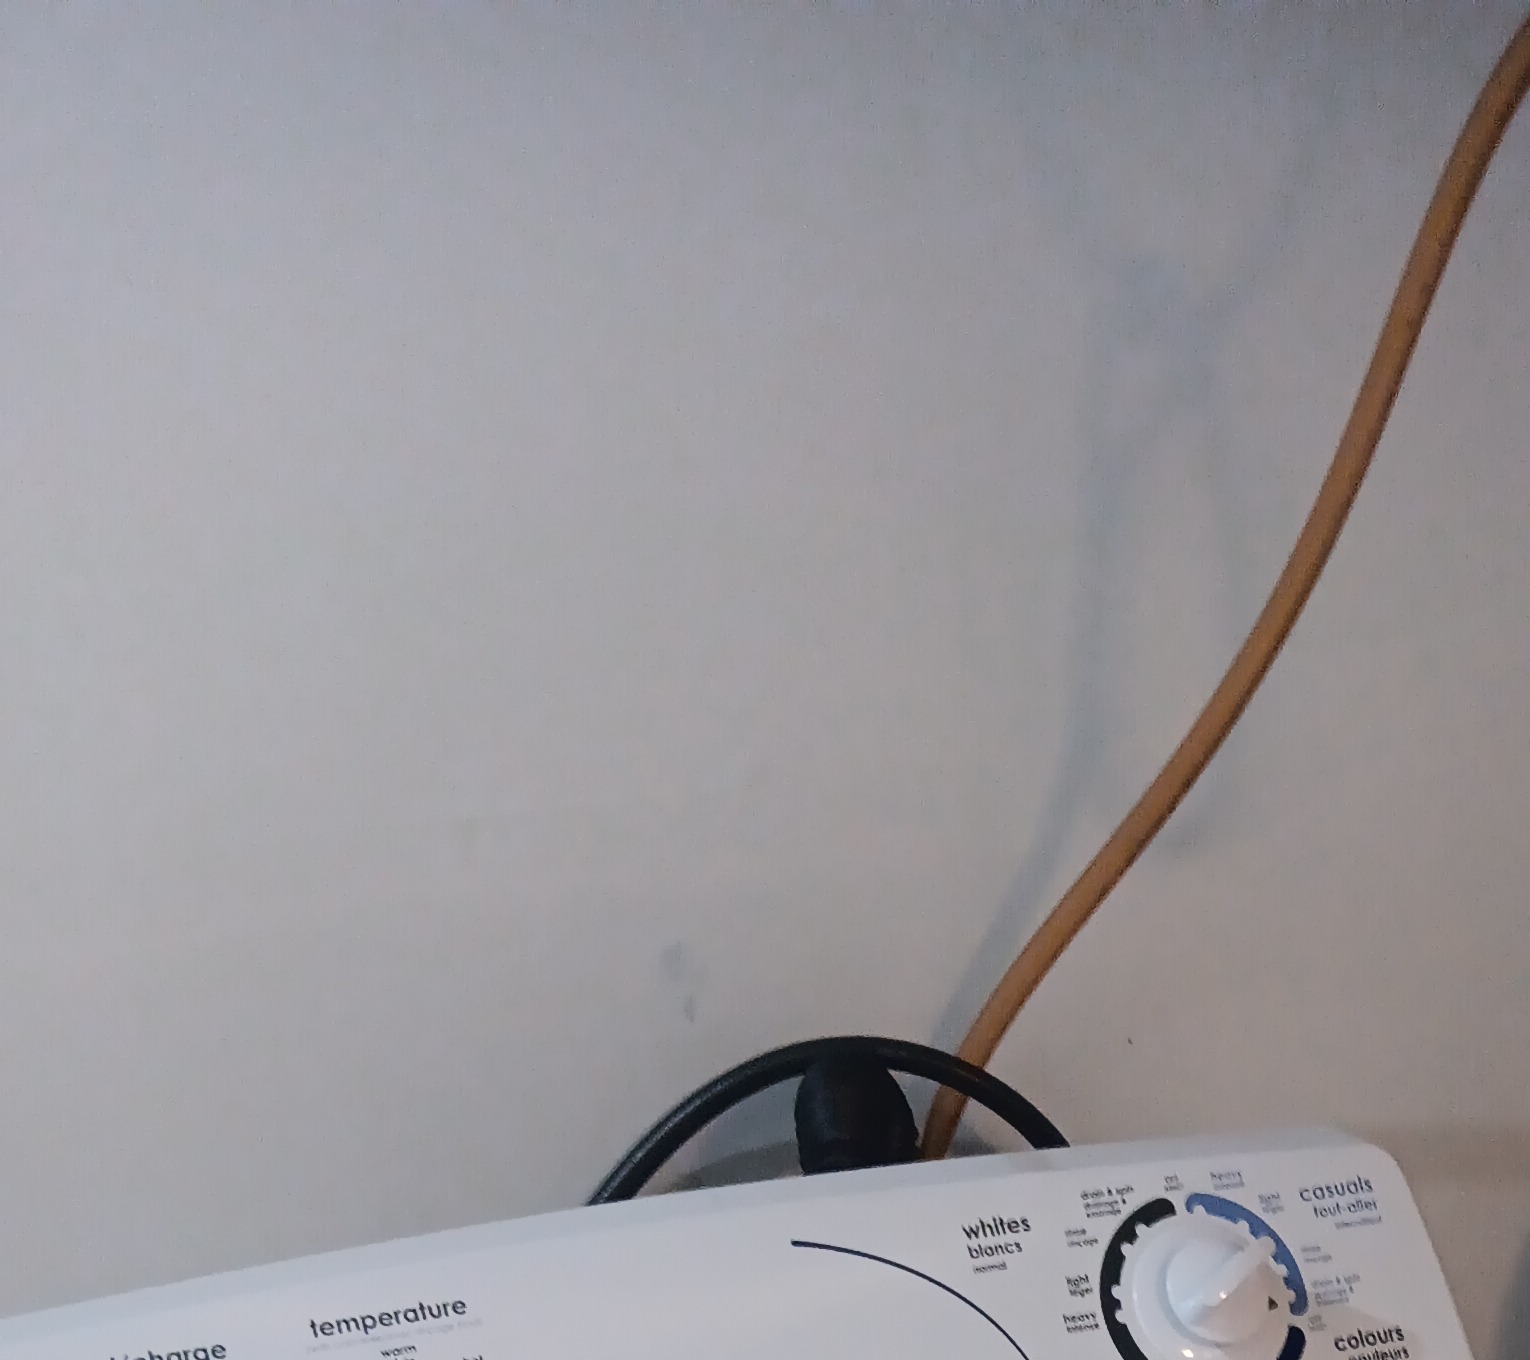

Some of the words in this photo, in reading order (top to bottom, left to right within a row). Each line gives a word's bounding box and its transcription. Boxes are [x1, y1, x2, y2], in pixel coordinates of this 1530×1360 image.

[1300, 1175, 1374, 1202] casuals
[962, 1215, 1031, 1241] whites
[967, 1242, 1023, 1259] blancs
[310, 1299, 467, 1338] temperature
[1062, 1312, 1097, 1326] heavy
[380, 1344, 418, 1358] warm
[1334, 1324, 1405, 1352] colours
